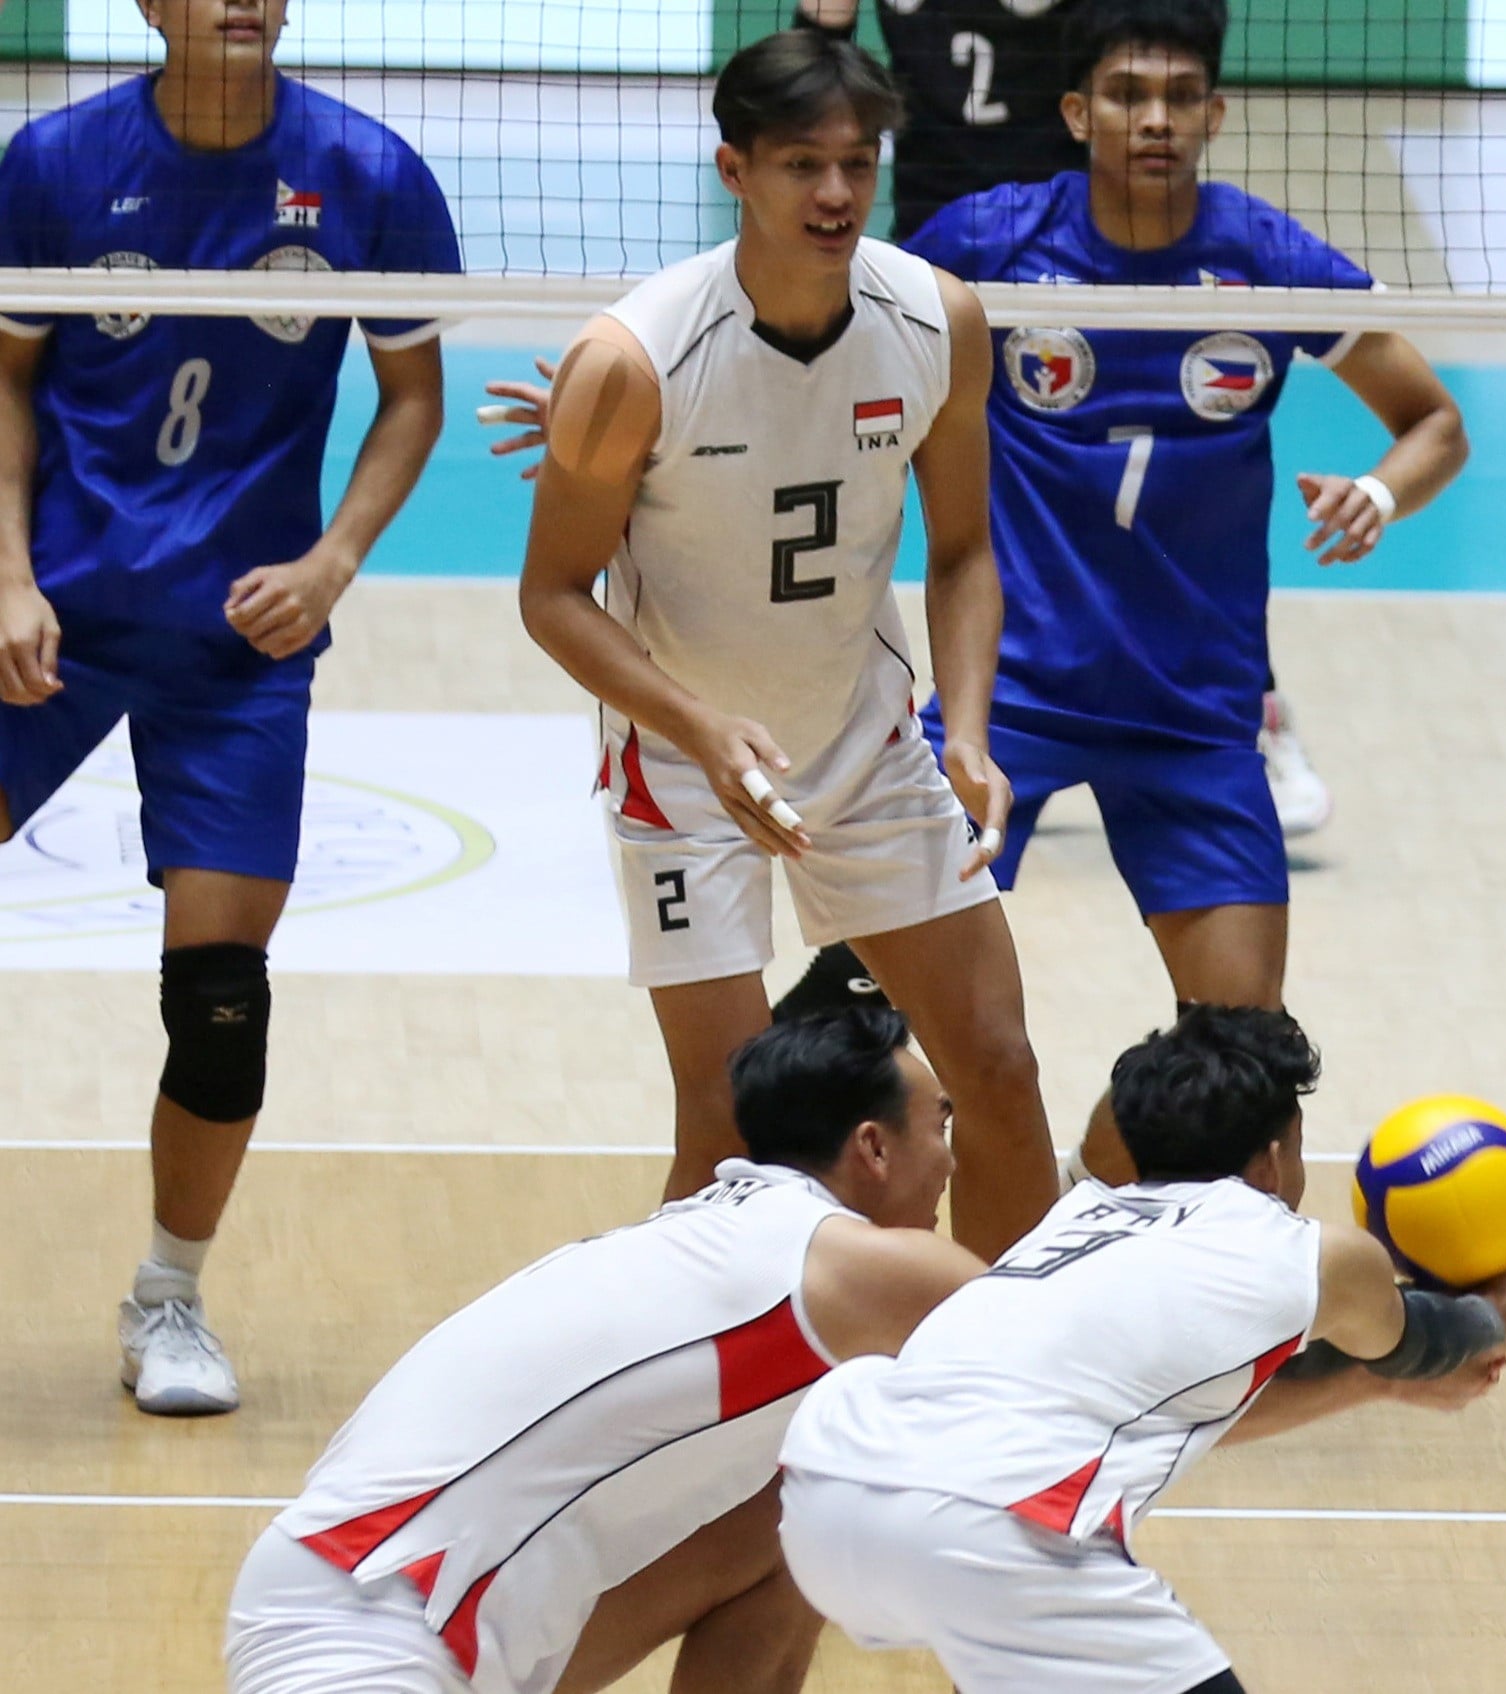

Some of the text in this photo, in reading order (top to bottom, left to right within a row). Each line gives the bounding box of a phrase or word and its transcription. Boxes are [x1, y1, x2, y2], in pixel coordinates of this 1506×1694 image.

[951, 31, 1008, 125] 2
[156, 357, 212, 466] 8
[857, 434, 899, 451] INA
[1107, 425, 1155, 531] 7
[770, 479, 844, 603] 2
[654, 869, 690, 932] 2
